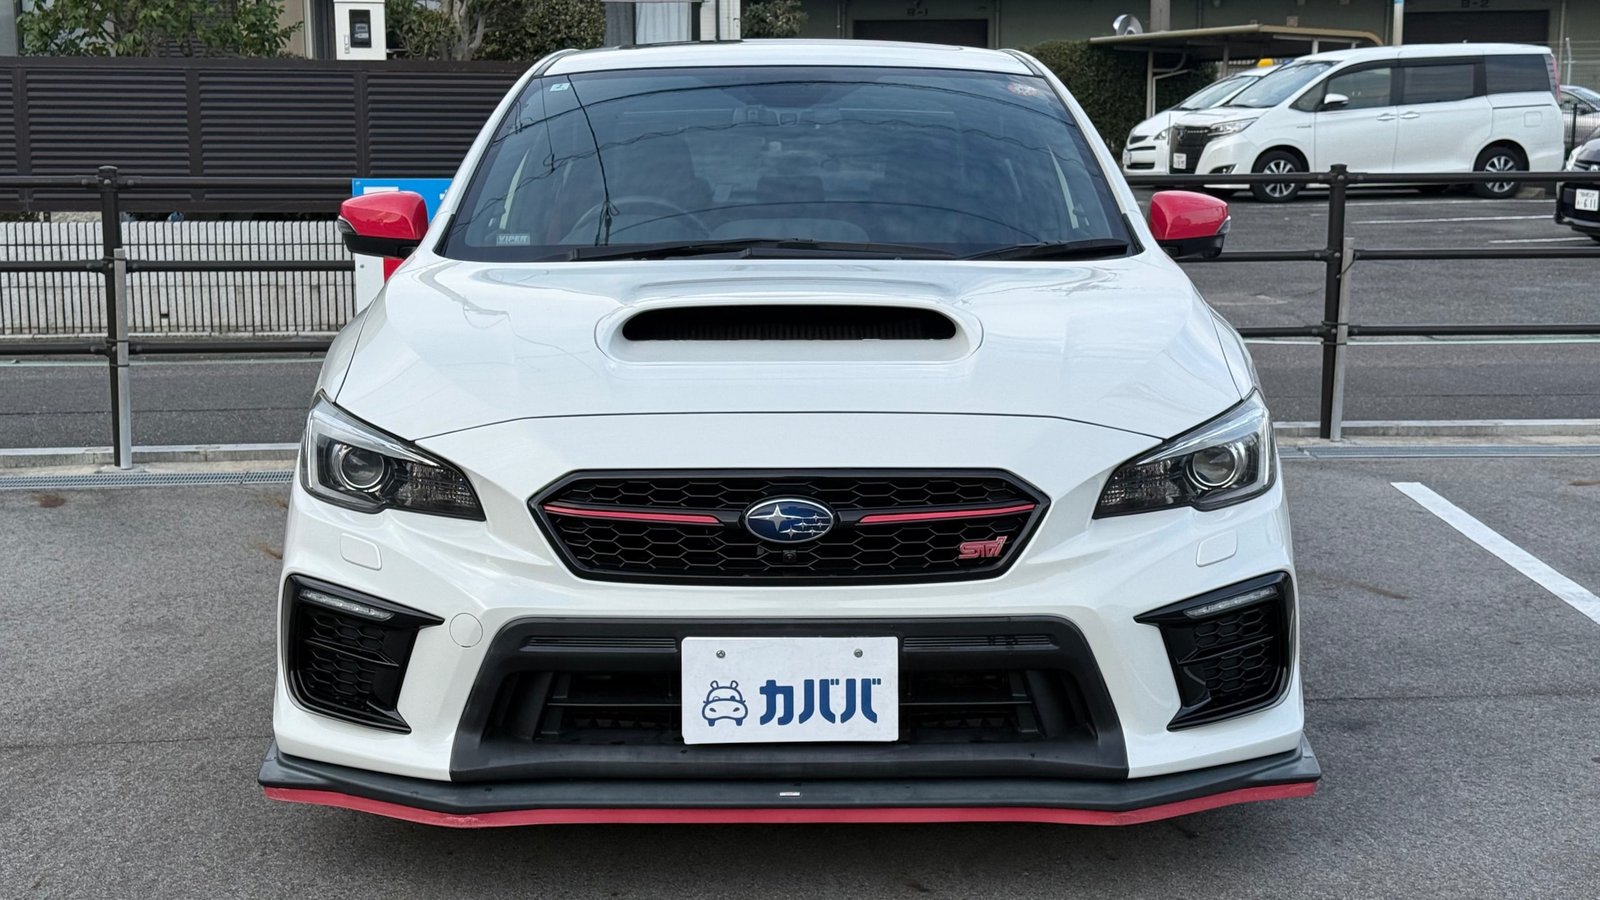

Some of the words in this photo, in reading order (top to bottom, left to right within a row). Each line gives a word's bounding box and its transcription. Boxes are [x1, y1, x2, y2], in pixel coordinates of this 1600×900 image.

[498, 235, 529, 243] VIPER
[759, 678, 881, 725] カババ
